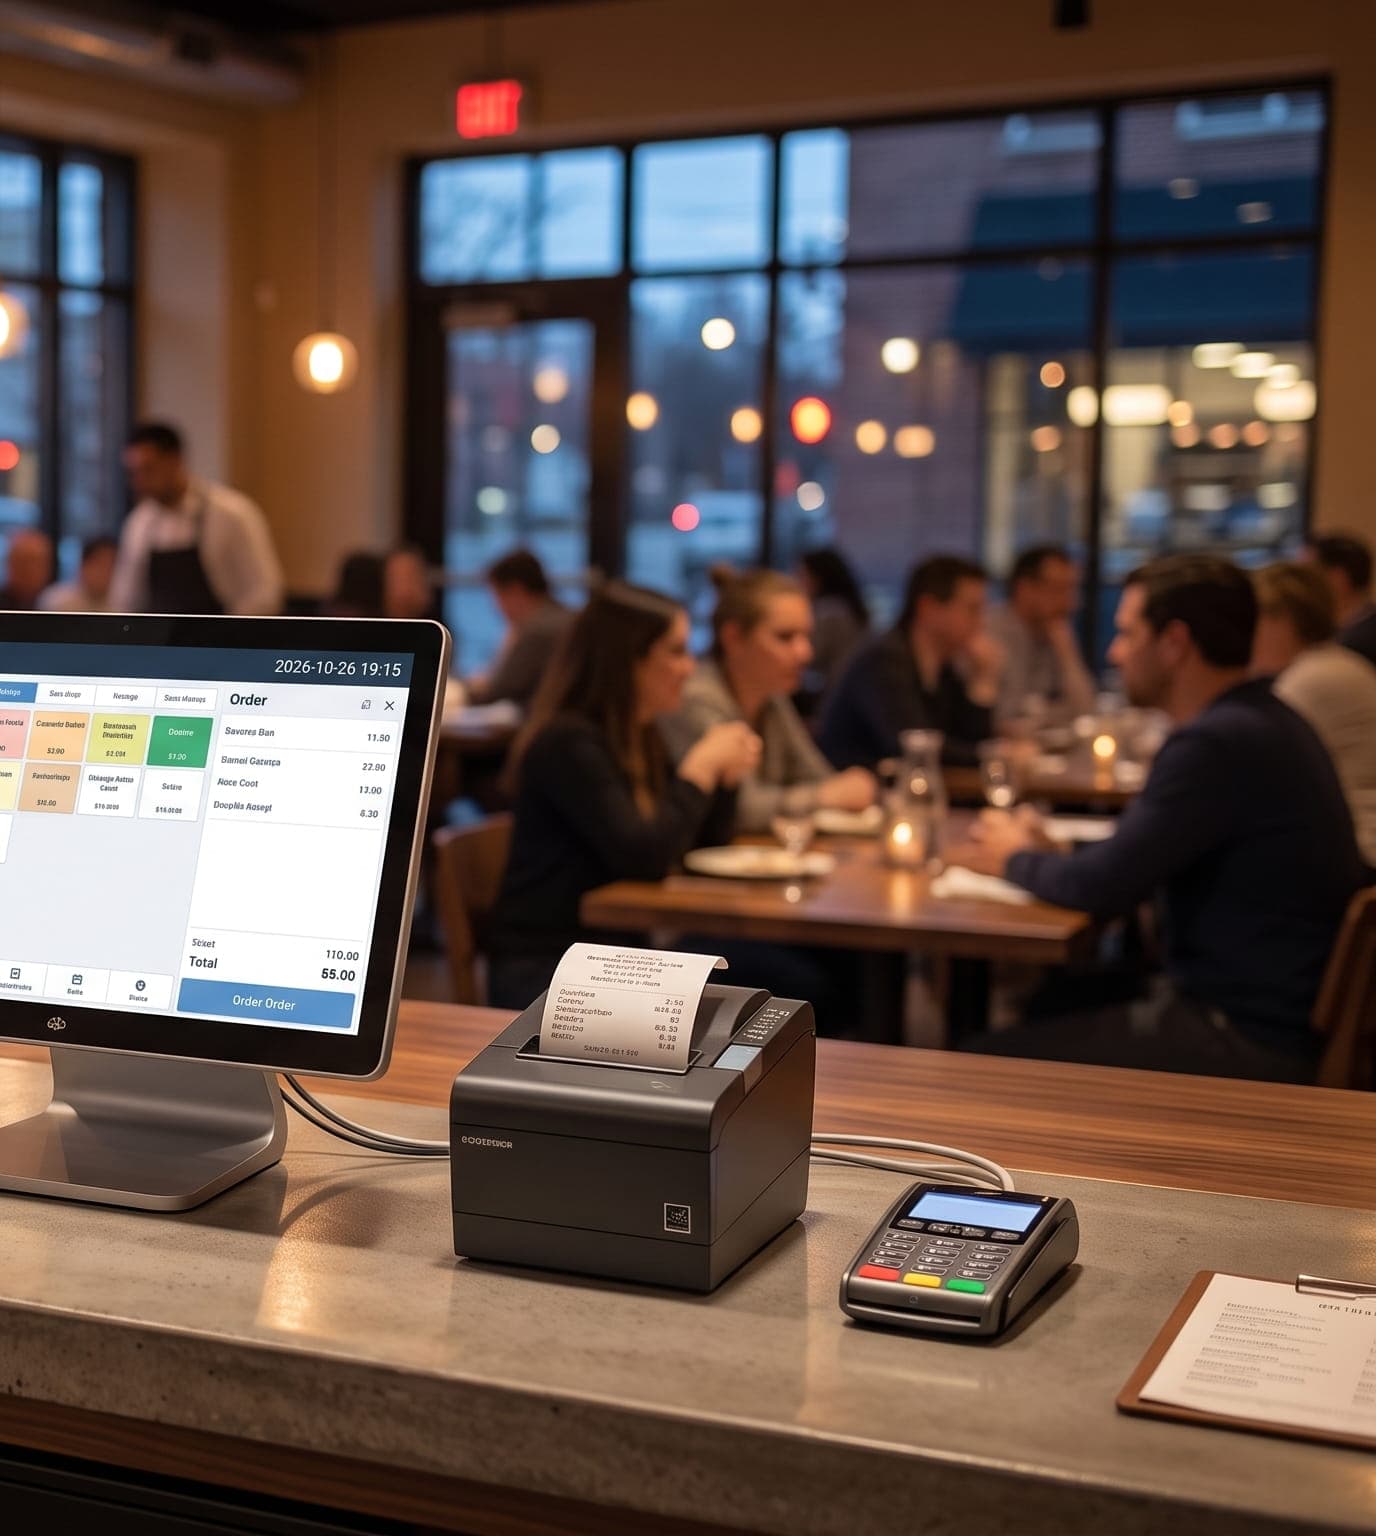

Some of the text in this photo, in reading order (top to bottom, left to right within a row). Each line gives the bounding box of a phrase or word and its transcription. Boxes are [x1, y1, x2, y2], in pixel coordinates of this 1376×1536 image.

[274, 659, 402, 677] 2026-10-26 19:15
[230, 692, 268, 706] Order
[258, 728, 275, 737] Ban
[367, 733, 391, 742] 11.50
[189, 955, 218, 969] Total
[326, 949, 360, 961] 110.00
[321, 967, 356, 982] 55.00
[232, 994, 296, 1011] Order Order
